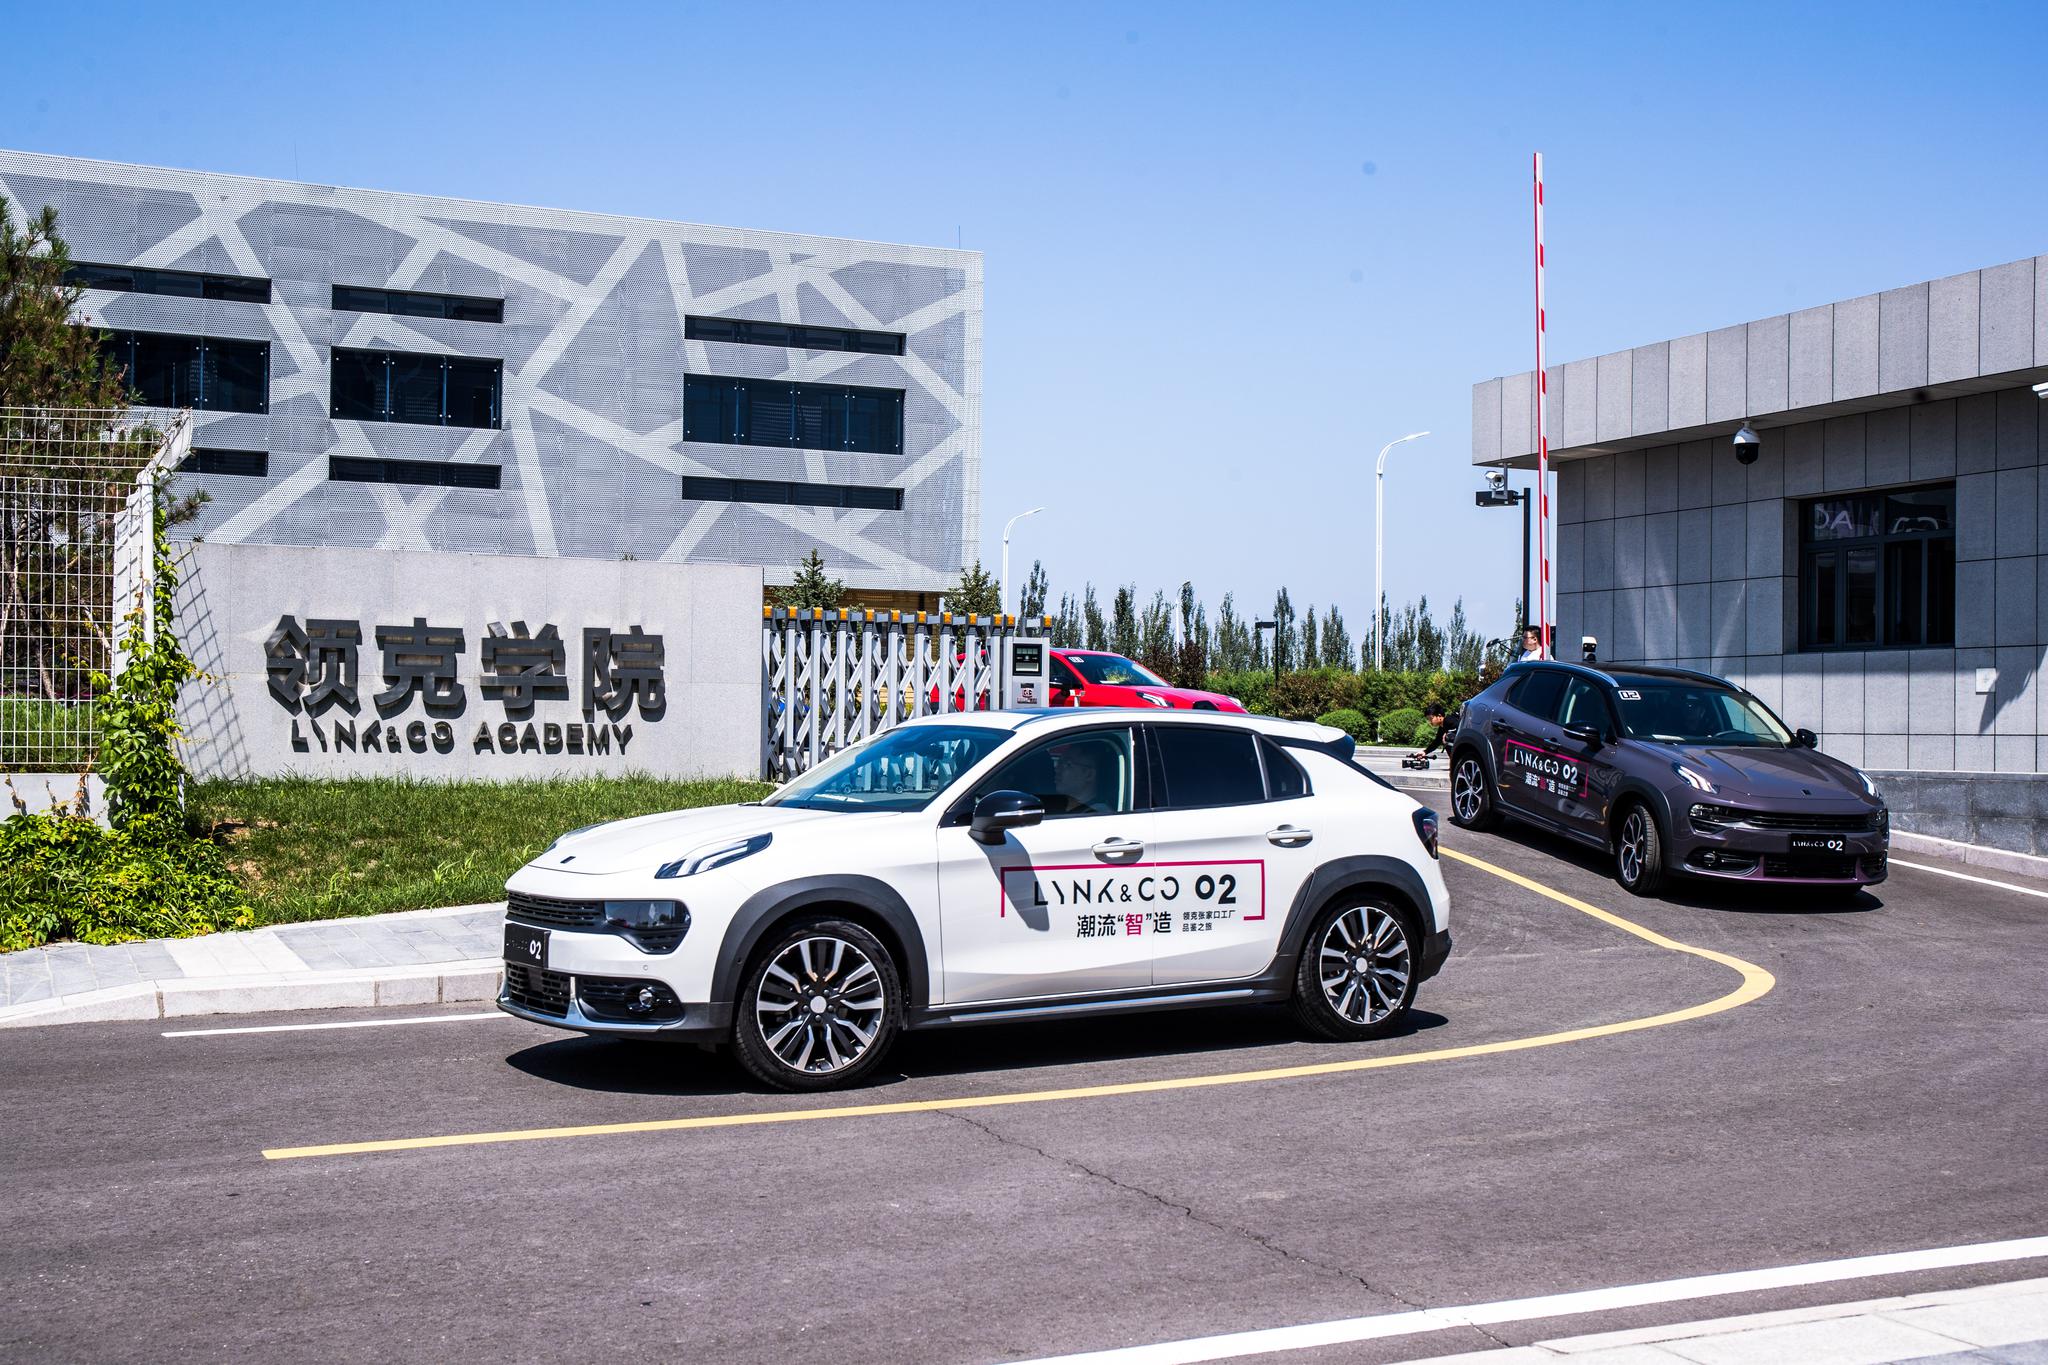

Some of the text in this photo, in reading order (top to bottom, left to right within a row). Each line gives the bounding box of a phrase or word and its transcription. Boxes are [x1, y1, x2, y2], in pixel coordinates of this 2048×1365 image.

[263, 614, 666, 721] 领克学院
[1620, 691, 1639, 699] 02
[291, 719, 633, 756] LYNK&CO ACADEMY
[1563, 764, 1578, 785] 02
[1827, 840, 1843, 851] 02
[1034, 874, 1237, 906] LYNK&CO 02
[1182, 910, 1237, 920] 领克张家口工厂
[1182, 922, 1213, 932] 品鉴之旅
[529, 939, 542, 960] 02
